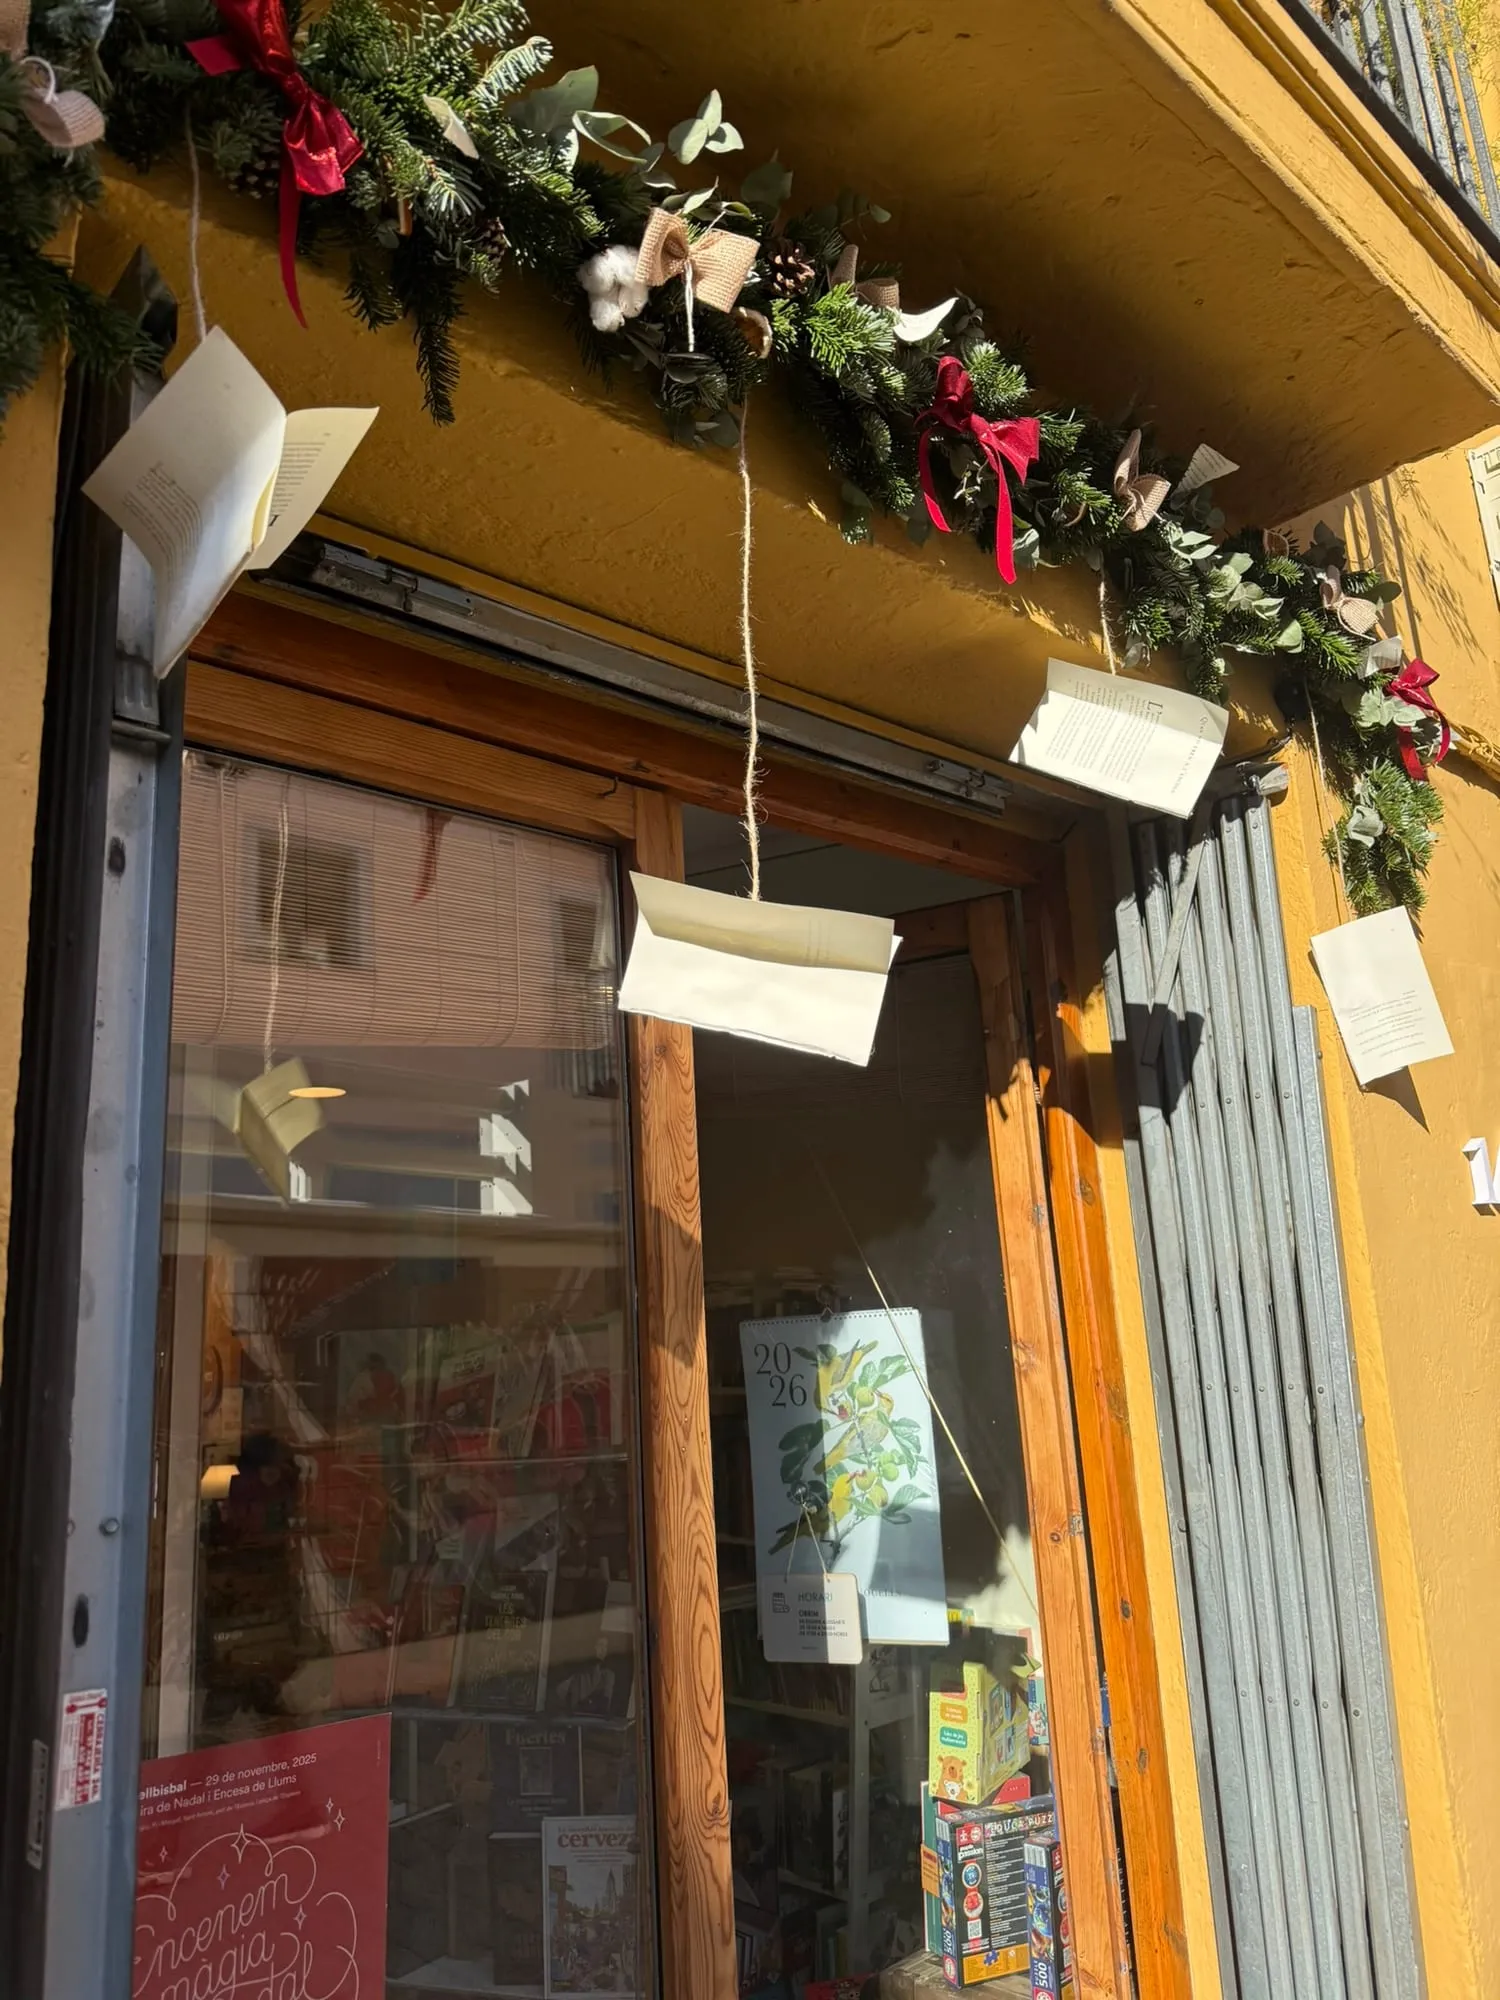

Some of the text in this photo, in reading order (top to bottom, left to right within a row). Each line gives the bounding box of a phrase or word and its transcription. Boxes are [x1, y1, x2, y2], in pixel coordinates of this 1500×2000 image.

[754, 1342, 791, 1376] 20
[769, 1373, 807, 1409] 26
[797, 1591, 833, 1603] HORARI
[205, 1774, 219, 1787] 29
[221, 1771, 235, 1782] de
[238, 1760, 290, 1780] novembre,
[292, 1752, 317, 1768] 2025
[156, 1799, 171, 1813] de
[173, 1792, 206, 1810] Nadal
[206, 1790, 212, 1801] i
[213, 1785, 250, 1801] Encesa
[252, 1780, 266, 1792] de
[268, 1773, 297, 1789] Llums
[557, 1831, 638, 1849] cervez
[1038, 1962, 1048, 1988] 500
